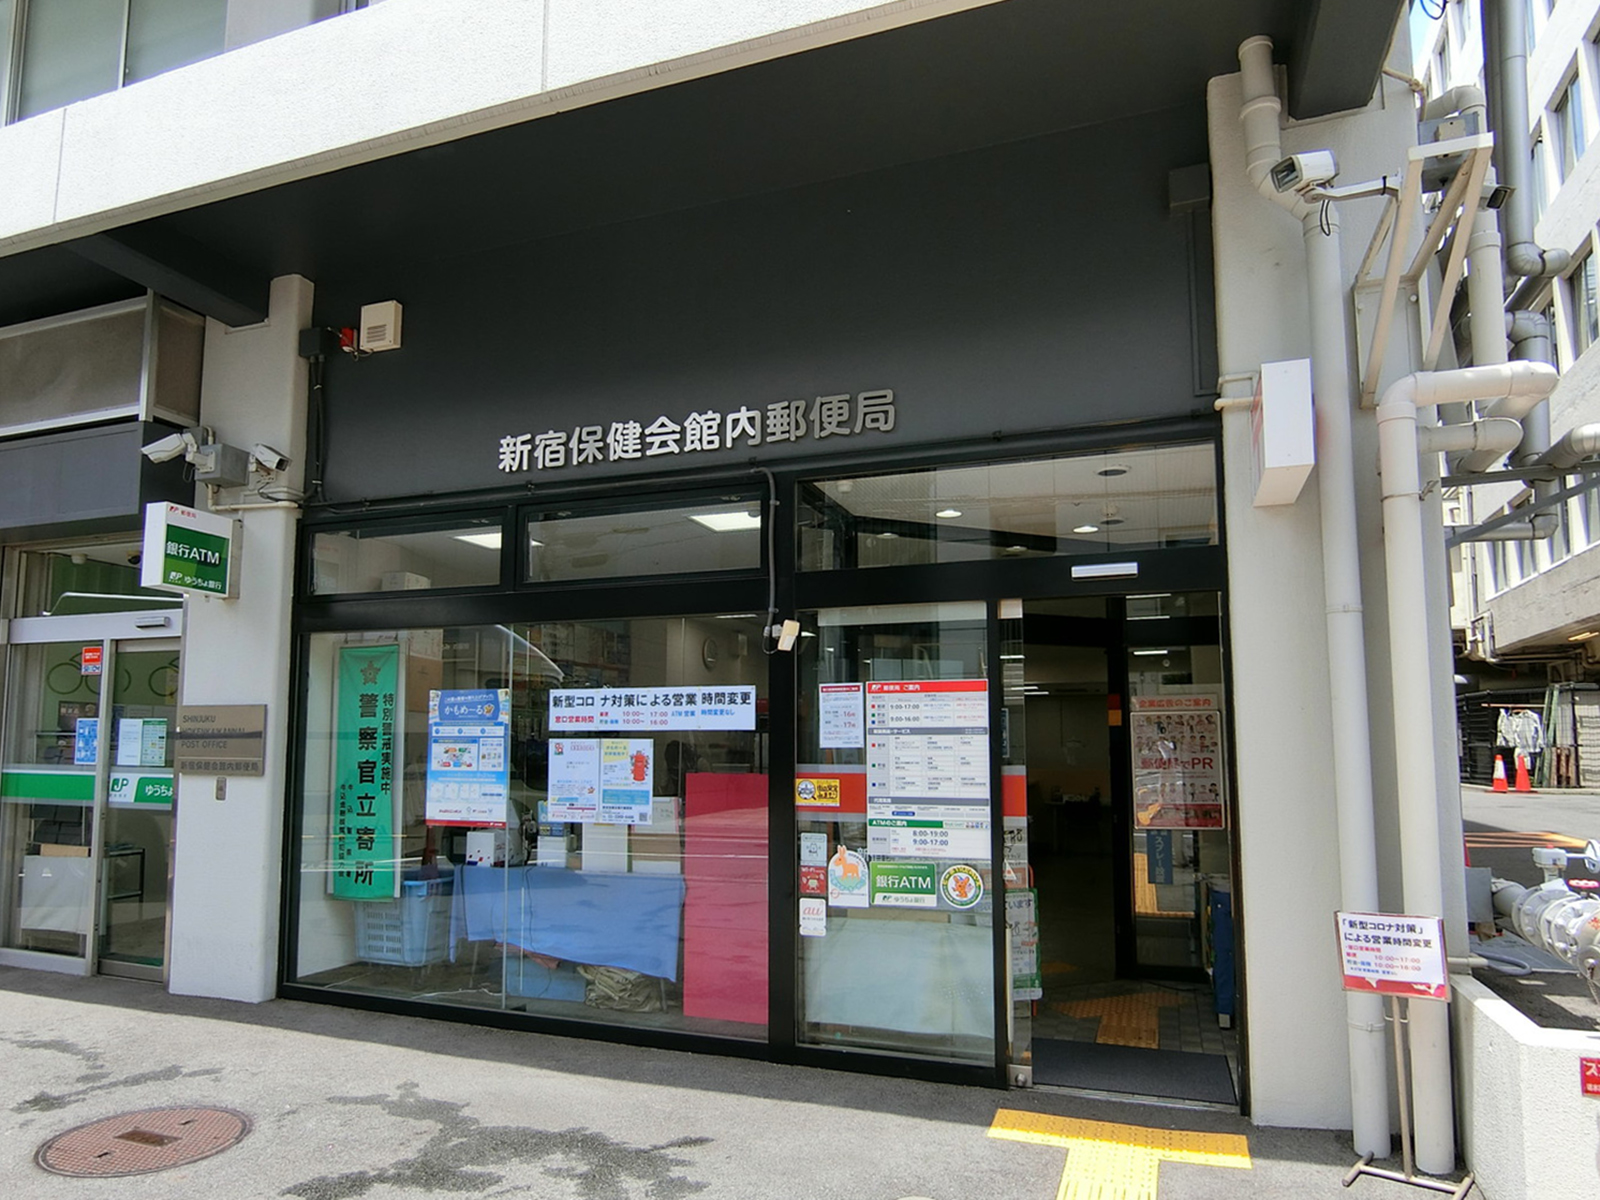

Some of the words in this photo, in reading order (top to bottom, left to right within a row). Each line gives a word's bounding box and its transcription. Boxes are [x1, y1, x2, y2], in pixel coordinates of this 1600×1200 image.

[497, 389, 896, 474] 新宿保健会館内郵便局
[166, 541, 220, 565] 銀行ATM
[354, 692, 378, 886] 警察官立寄所
[876, 875, 931, 889] 銀行ATM
[803, 907, 823, 916] au
[1344, 932, 1433, 949] による営業時間変更
